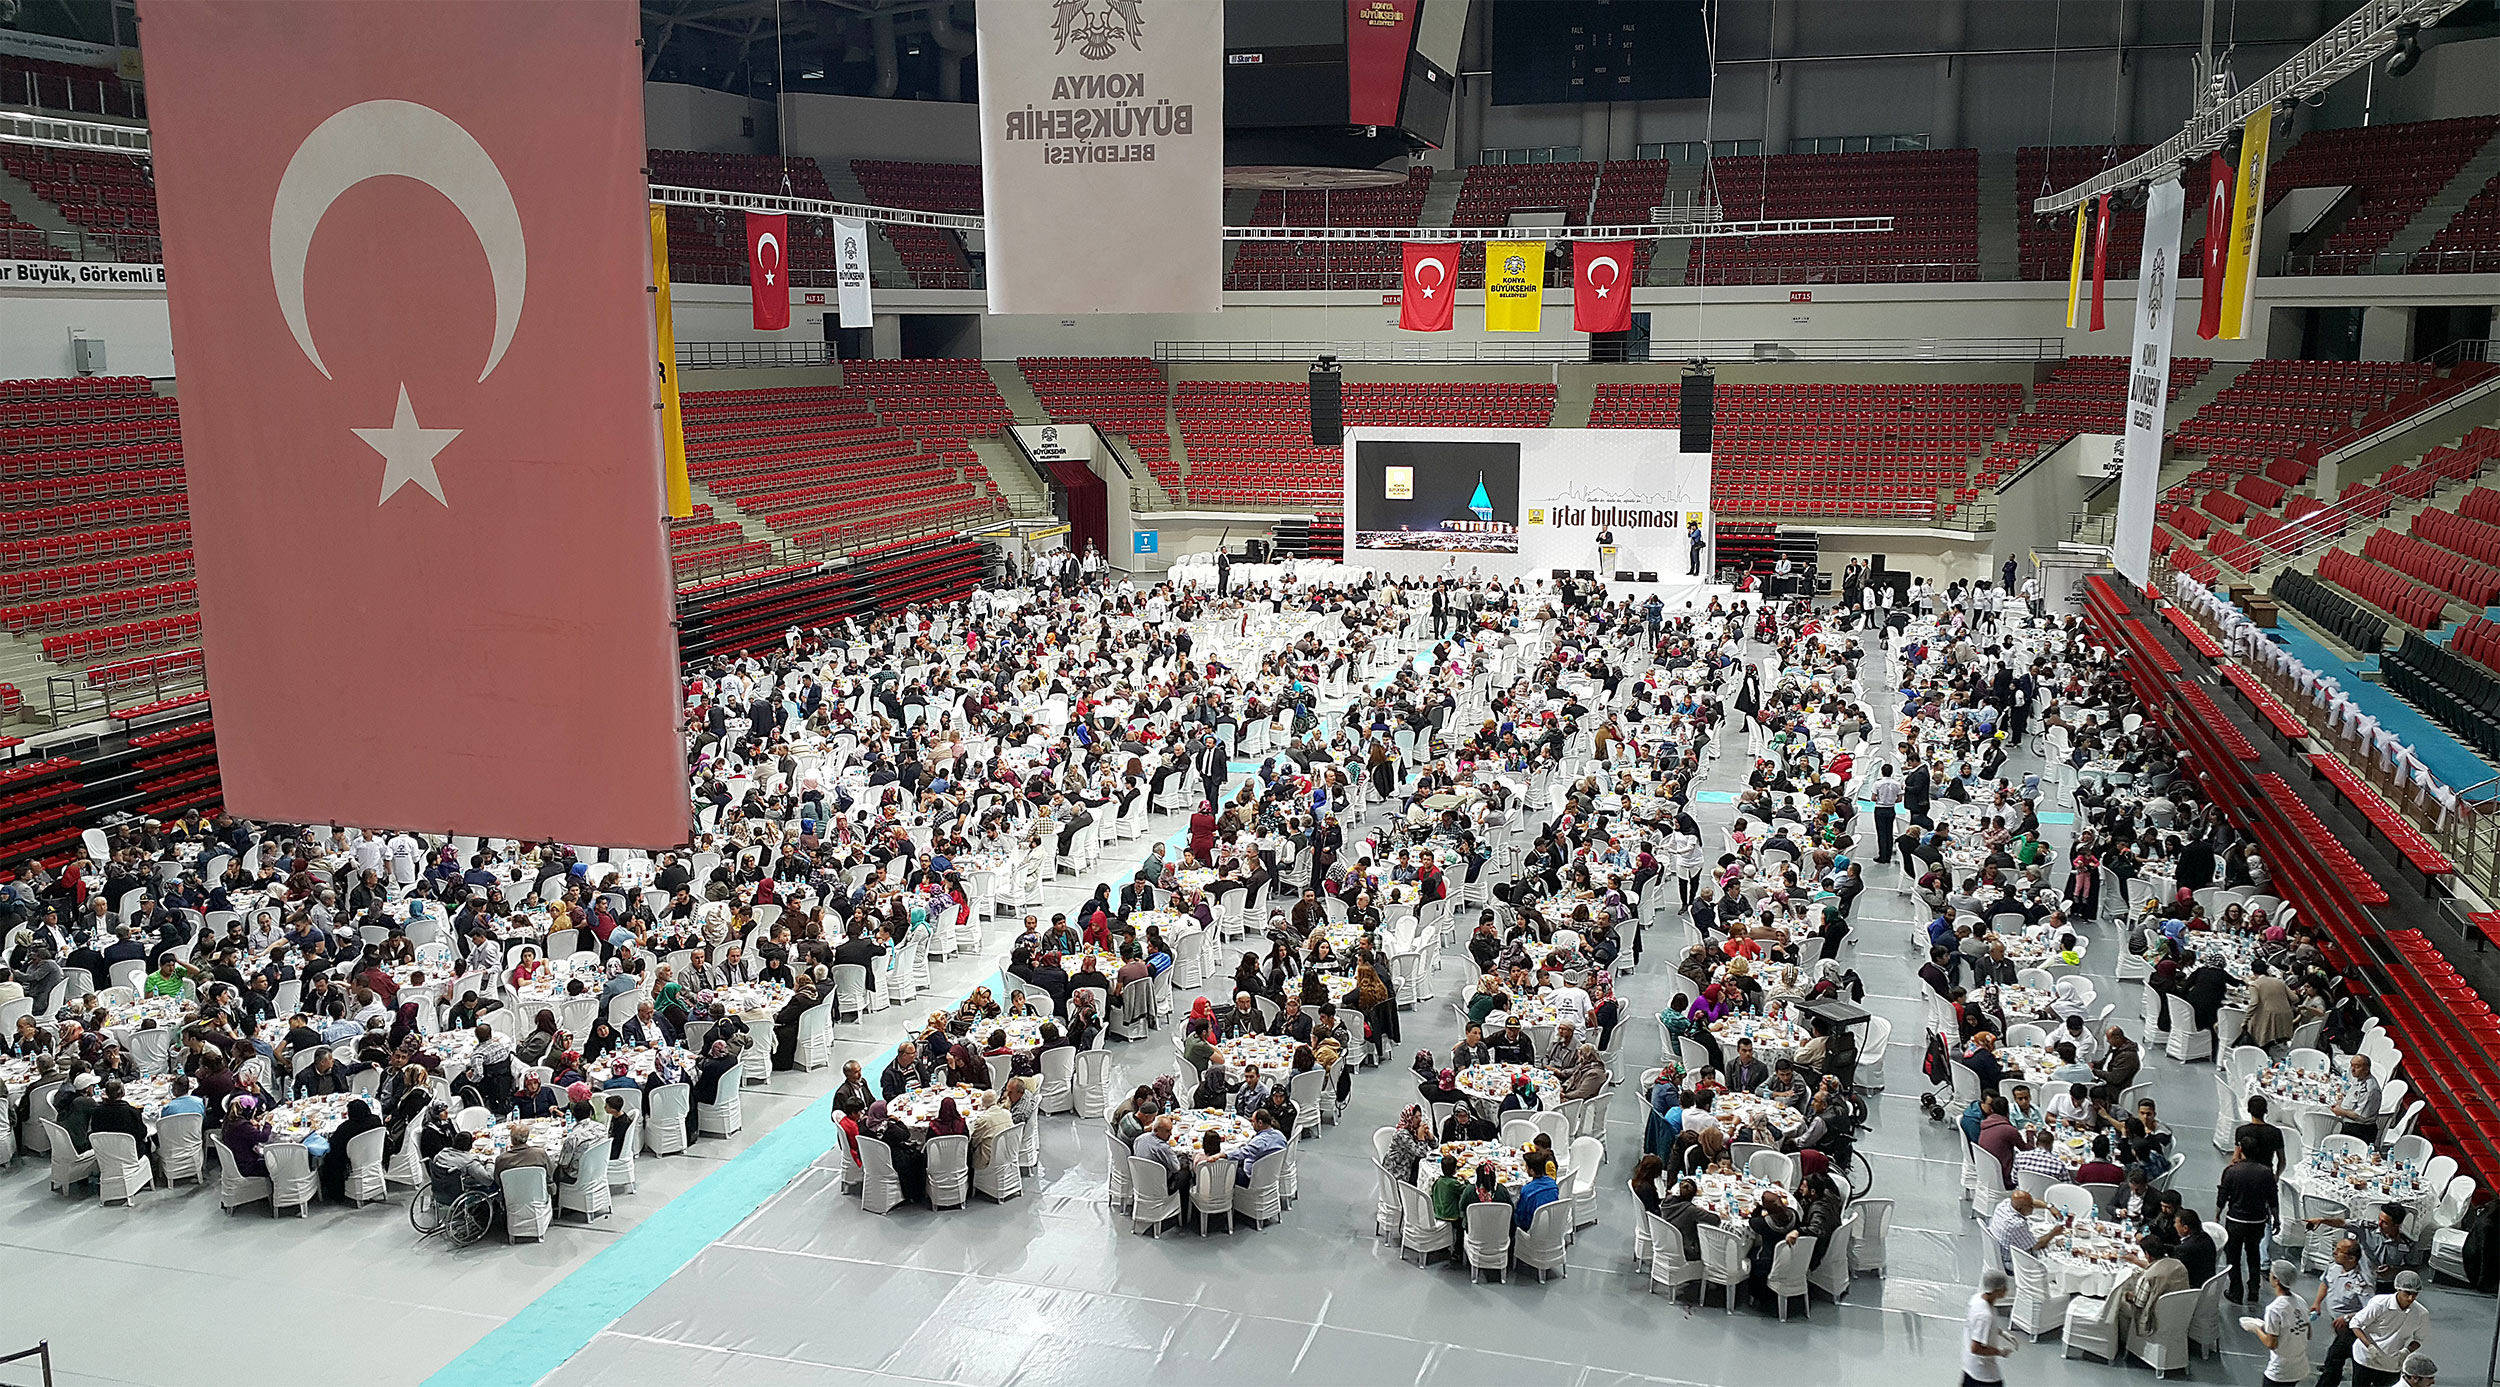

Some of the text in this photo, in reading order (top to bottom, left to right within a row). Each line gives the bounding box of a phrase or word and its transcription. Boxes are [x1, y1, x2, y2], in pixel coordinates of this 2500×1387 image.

[17, 264, 76, 285] Büyük,
[79, 265, 153, 284] Görkemli
[1490, 283, 1537, 293] BÜYÜKŞEHİR
[1551, 504, 1679, 530] iftar buluşması
